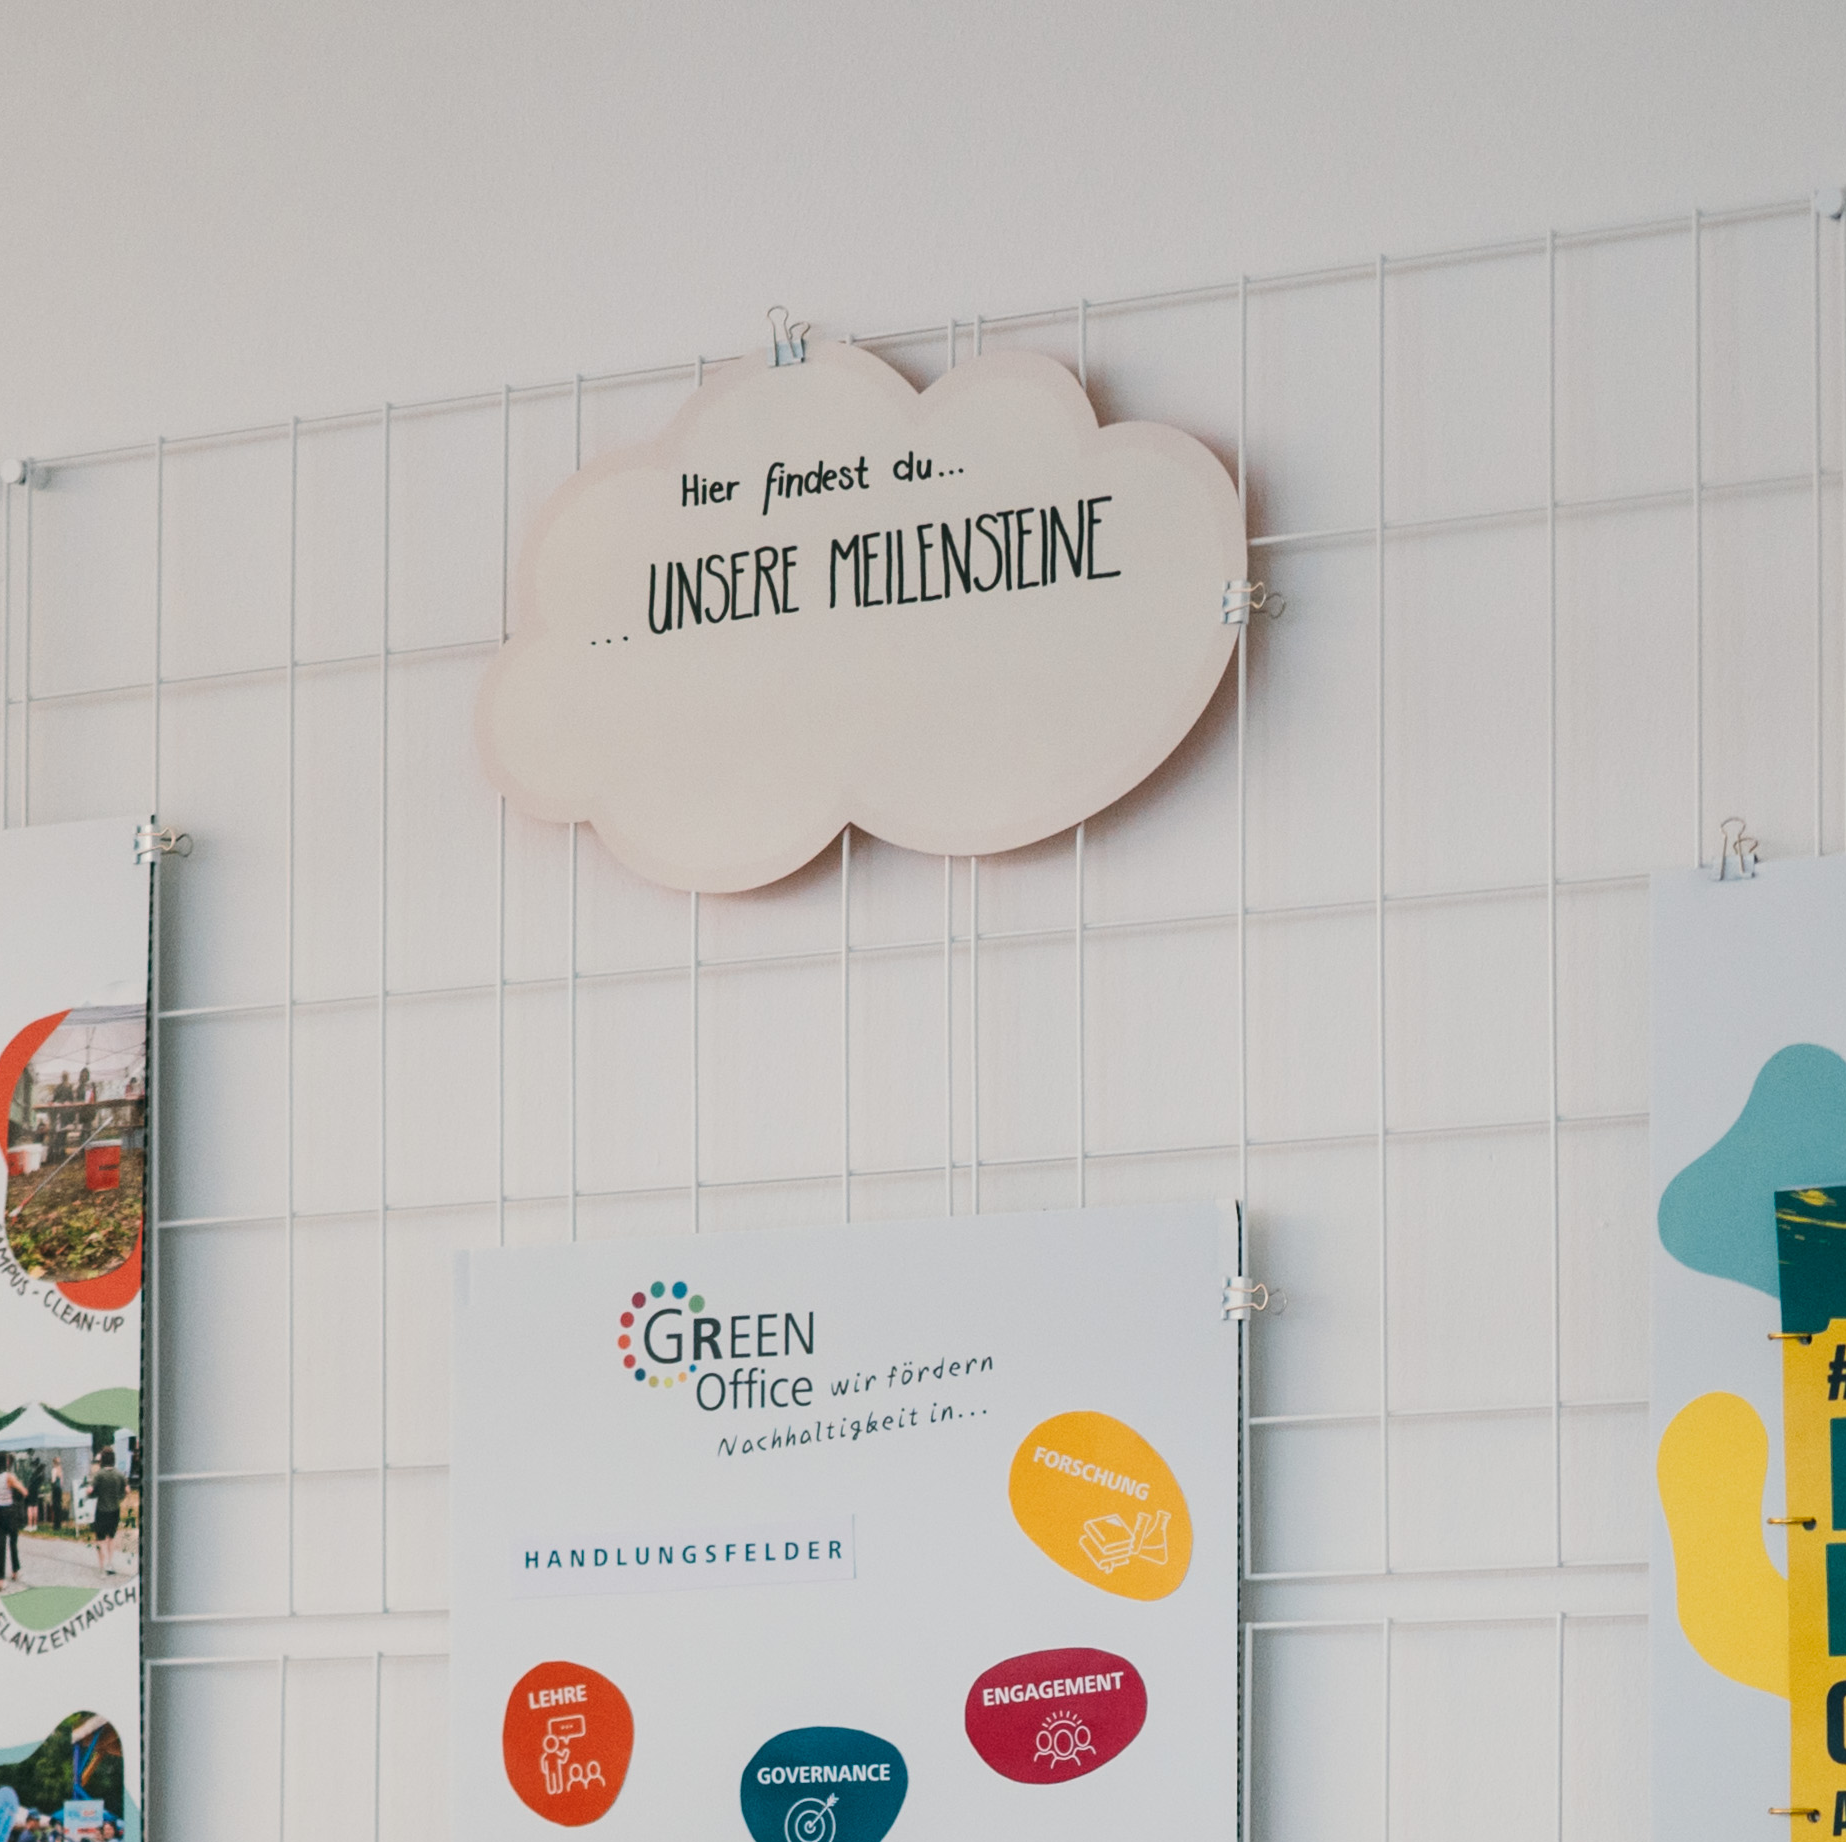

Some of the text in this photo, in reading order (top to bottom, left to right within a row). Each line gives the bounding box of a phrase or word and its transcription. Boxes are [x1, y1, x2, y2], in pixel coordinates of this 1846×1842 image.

[681, 451, 965, 515] Hier findest du...
[648, 545, 799, 634] UNSERE
[829, 496, 1121, 610] MEILENSTEINE
[643, 1307, 816, 1365] GREEN
[696, 1366, 814, 1411] Office
[831, 1353, 995, 1399] wir fördern
[717, 1405, 919, 1458] Nachhaltigkeit
[1032, 1446, 1152, 1502] FORSCHUNG
[524, 1539, 844, 1571] HANDLUNGSFELDER
[528, 1684, 588, 1712] LEHRE
[982, 1671, 1125, 1707] ENGAGEMENT
[756, 1761, 891, 1785] GOVERNANCE
